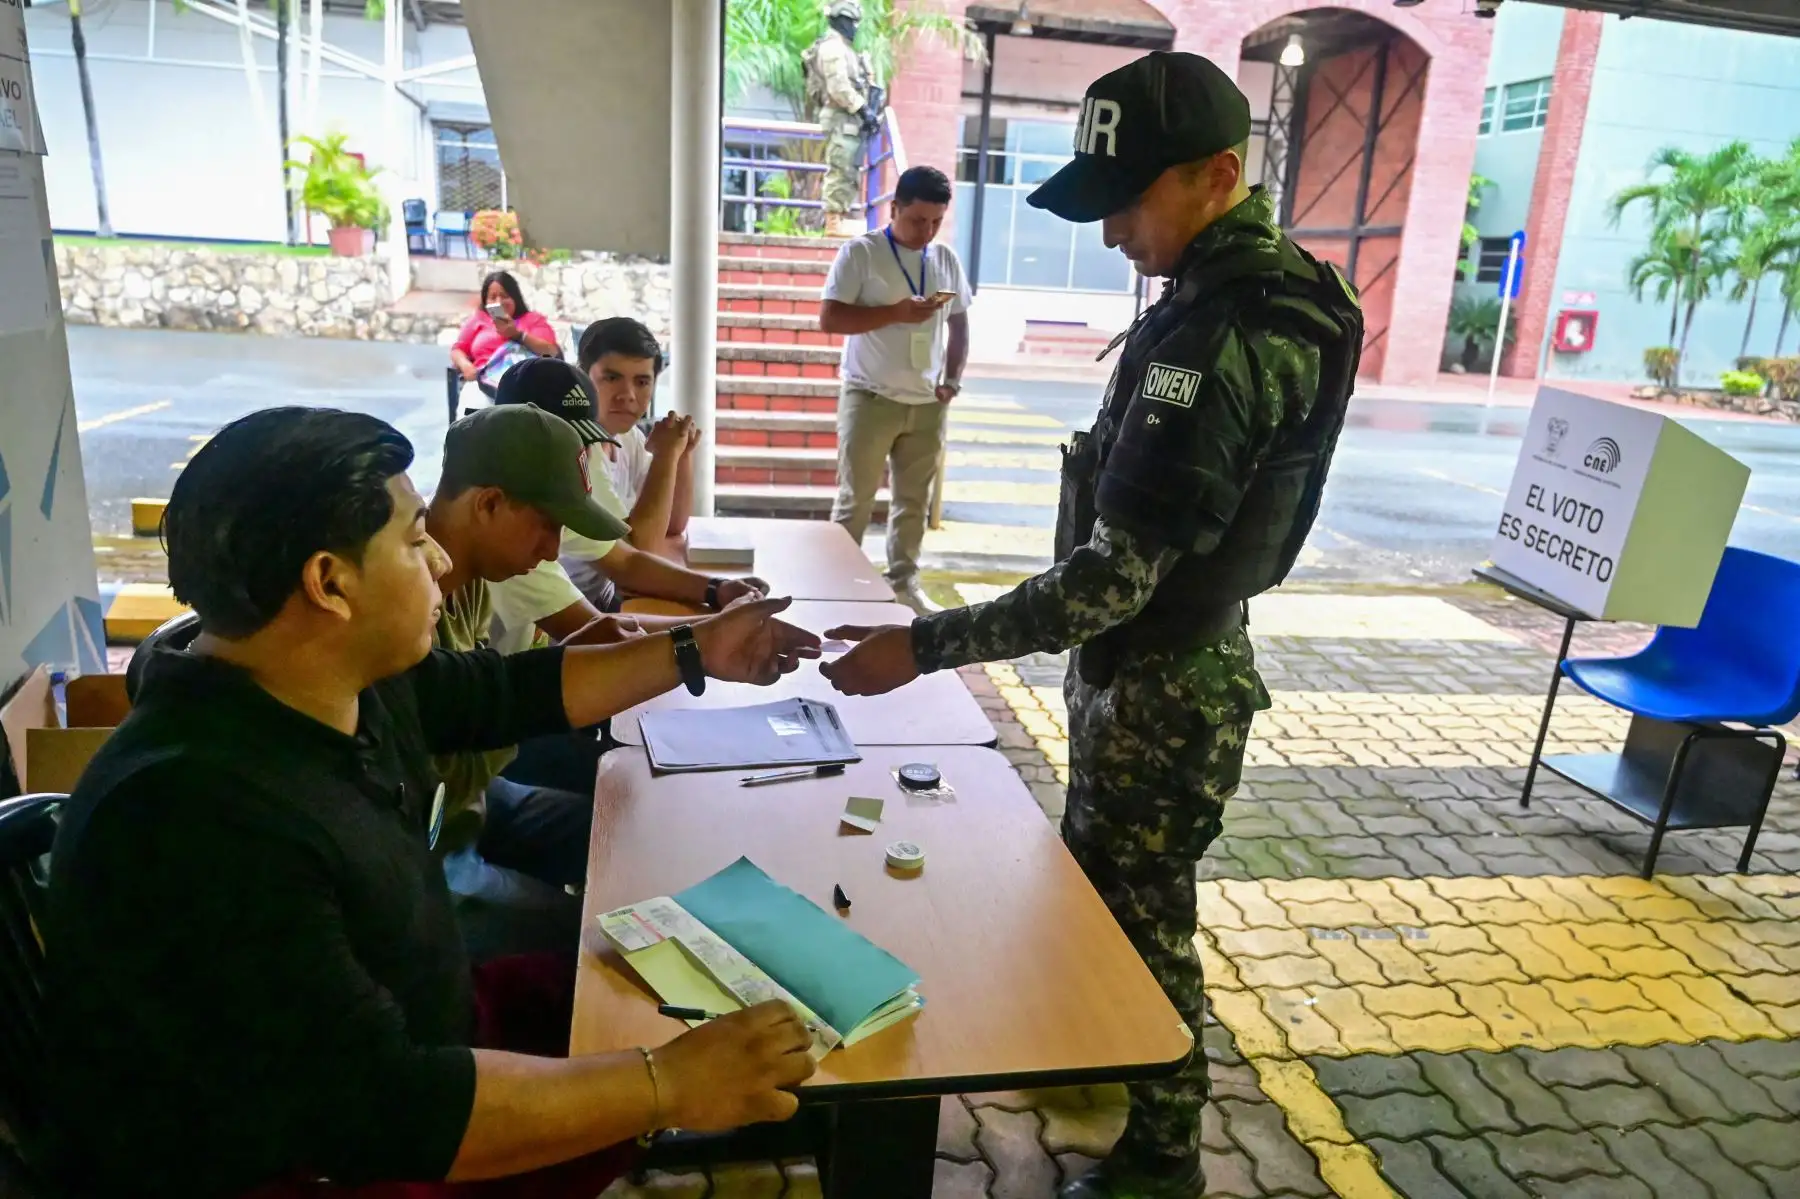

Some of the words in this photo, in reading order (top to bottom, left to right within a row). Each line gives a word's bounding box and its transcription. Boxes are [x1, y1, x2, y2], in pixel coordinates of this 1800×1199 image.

[0, 77, 21, 100] VO
[1147, 366, 1197, 403] OWEN
[1525, 484, 1545, 513] EL
[1552, 492, 1604, 534] VOTO
[1498, 513, 1523, 541] ES
[1523, 524, 1613, 583] SECRETO
